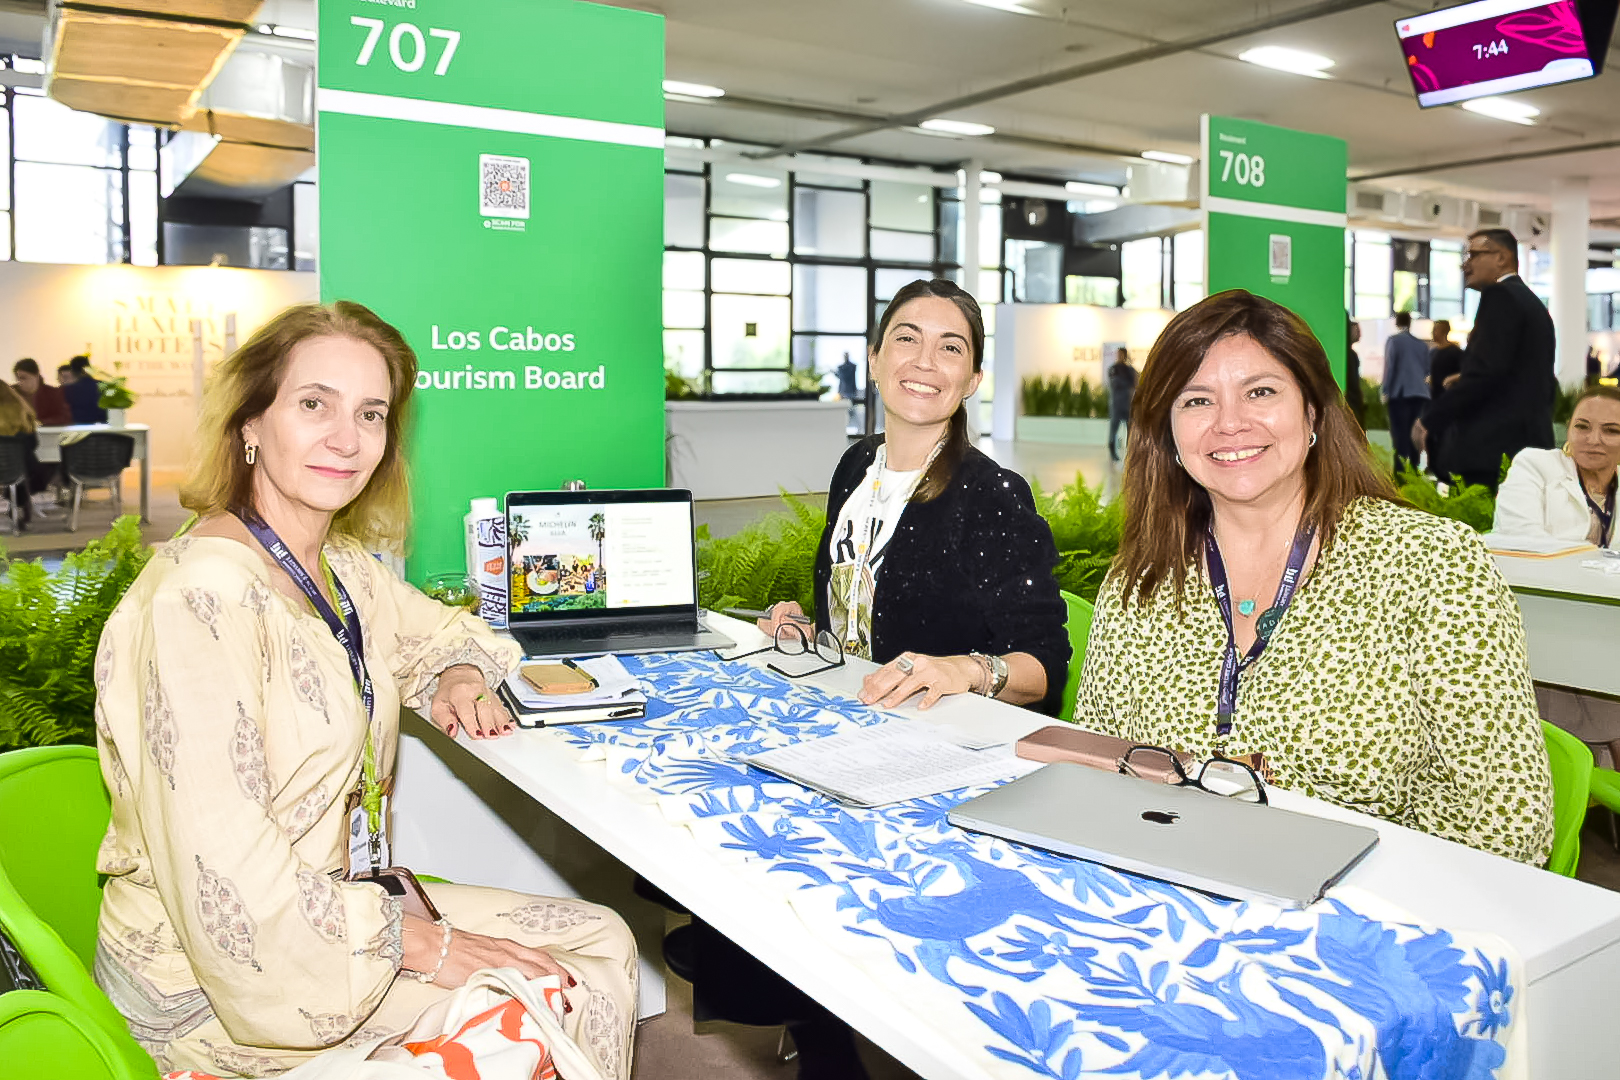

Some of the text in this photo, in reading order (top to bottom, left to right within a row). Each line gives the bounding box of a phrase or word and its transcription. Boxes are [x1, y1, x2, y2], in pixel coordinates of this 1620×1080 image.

[360, 0, 416, 9] evard
[350, 15, 461, 77] 707
[1472, 38, 1509, 60] 7:44
[1219, 149, 1265, 188] 708
[115, 335, 222, 354] HOTES
[431, 324, 576, 352] Los Cabos
[413, 364, 605, 390] ourism Board
